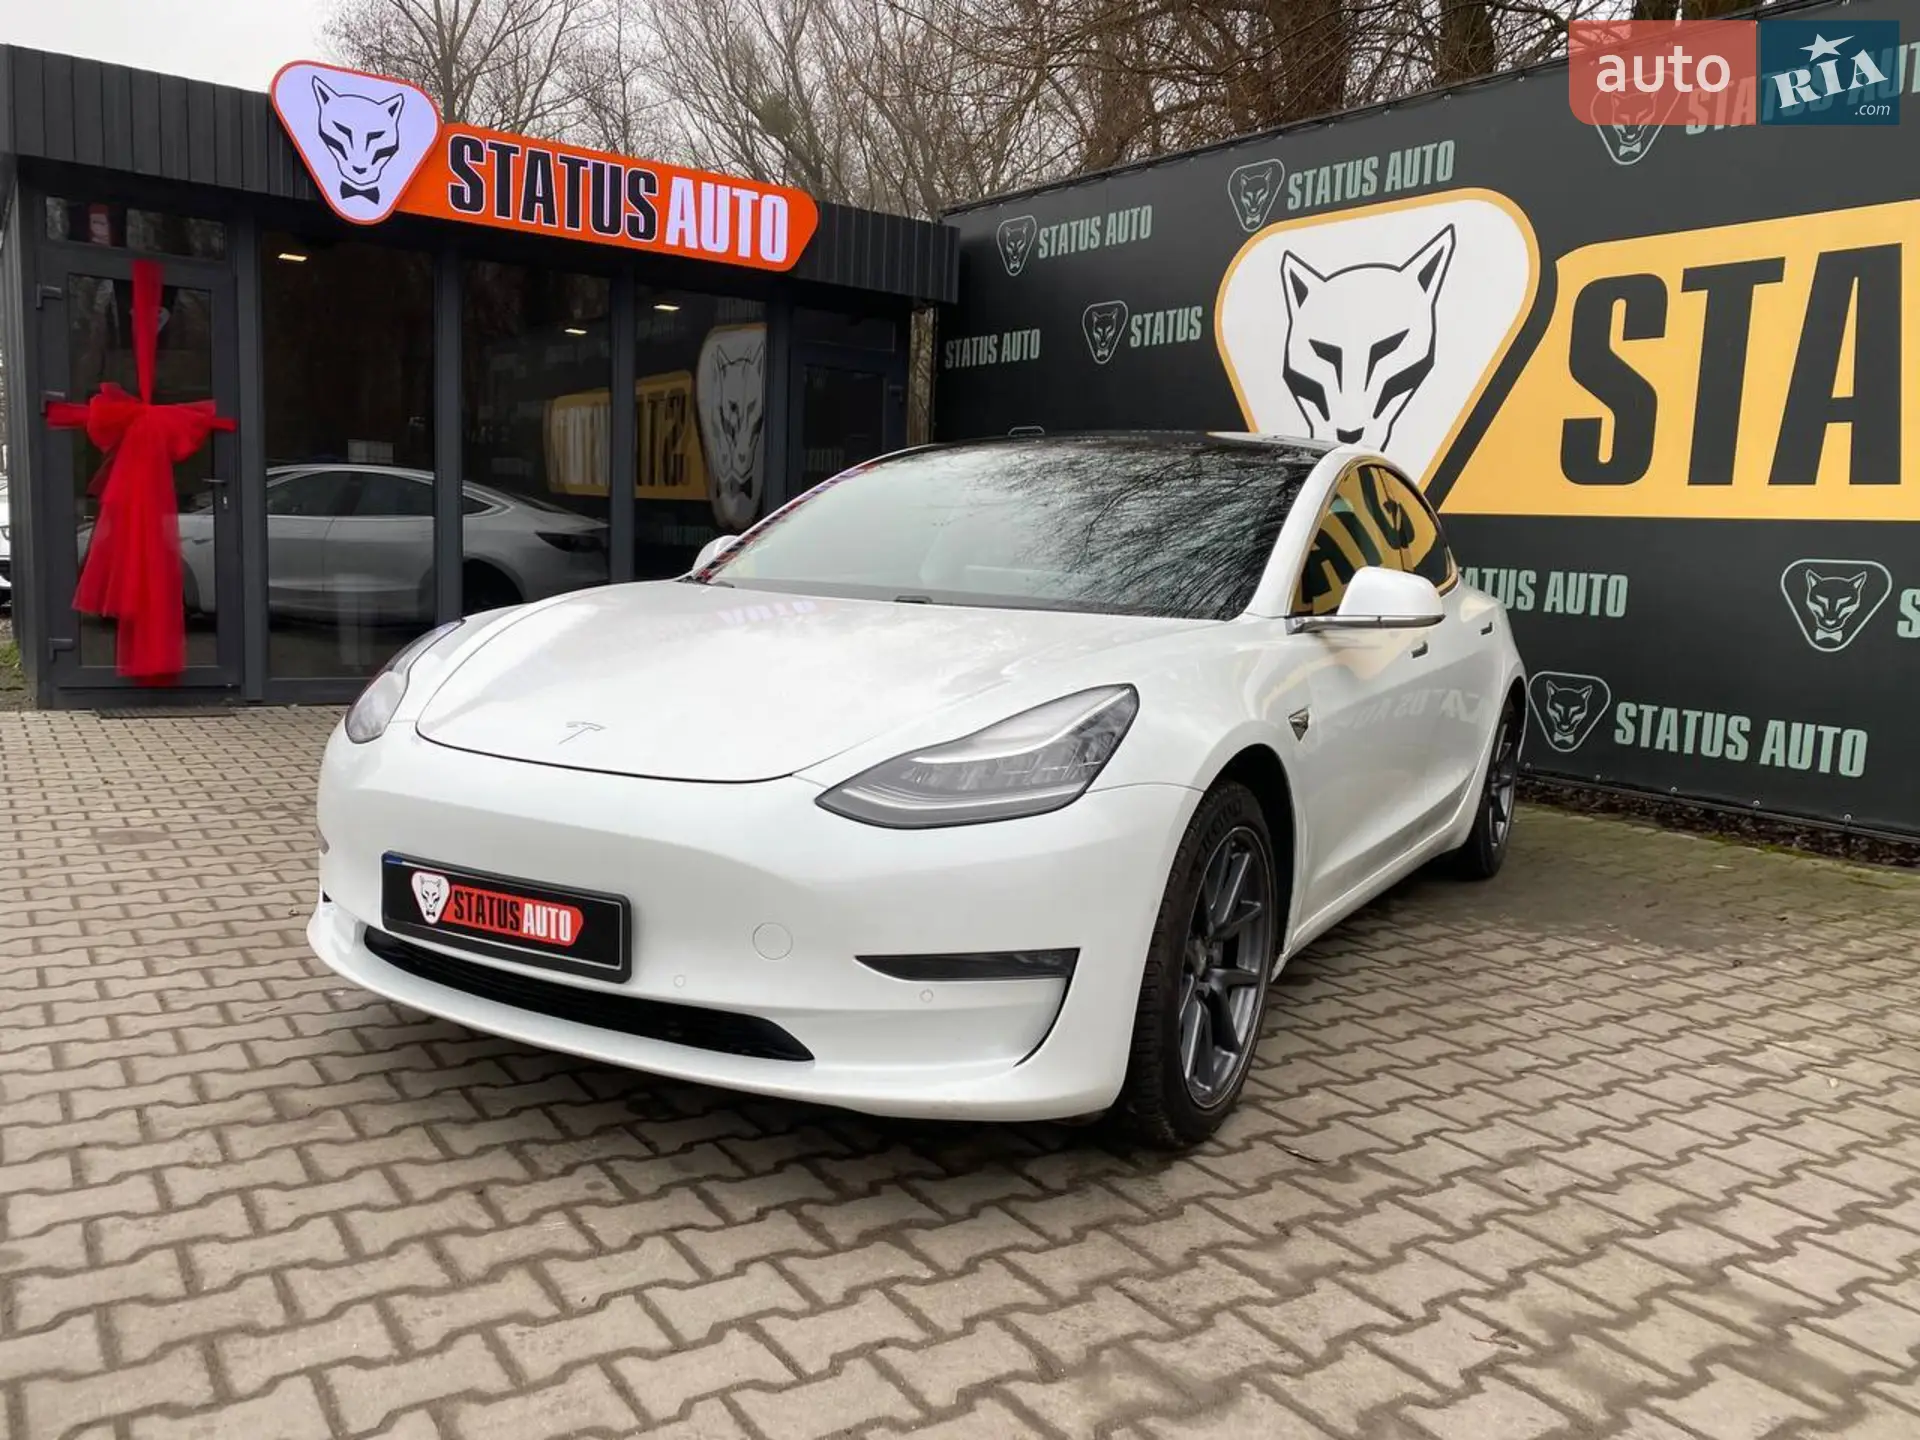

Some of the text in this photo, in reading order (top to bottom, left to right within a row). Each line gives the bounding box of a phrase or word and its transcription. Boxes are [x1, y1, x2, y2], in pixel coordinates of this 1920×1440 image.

[448, 134, 788, 263] STATUS AUTO
[1287, 140, 1455, 210] STATUS AUTO
[1038, 205, 1152, 260] STATUS AUTO
[945, 328, 1040, 369] STATUS AUTO
[1130, 306, 1203, 348] STATUS
[1560, 242, 1902, 486] STA
[1543, 571, 1629, 618] AUTO
[1614, 702, 1868, 777] STATUS AUTO
[453, 890, 571, 942] STATUS AUTO
